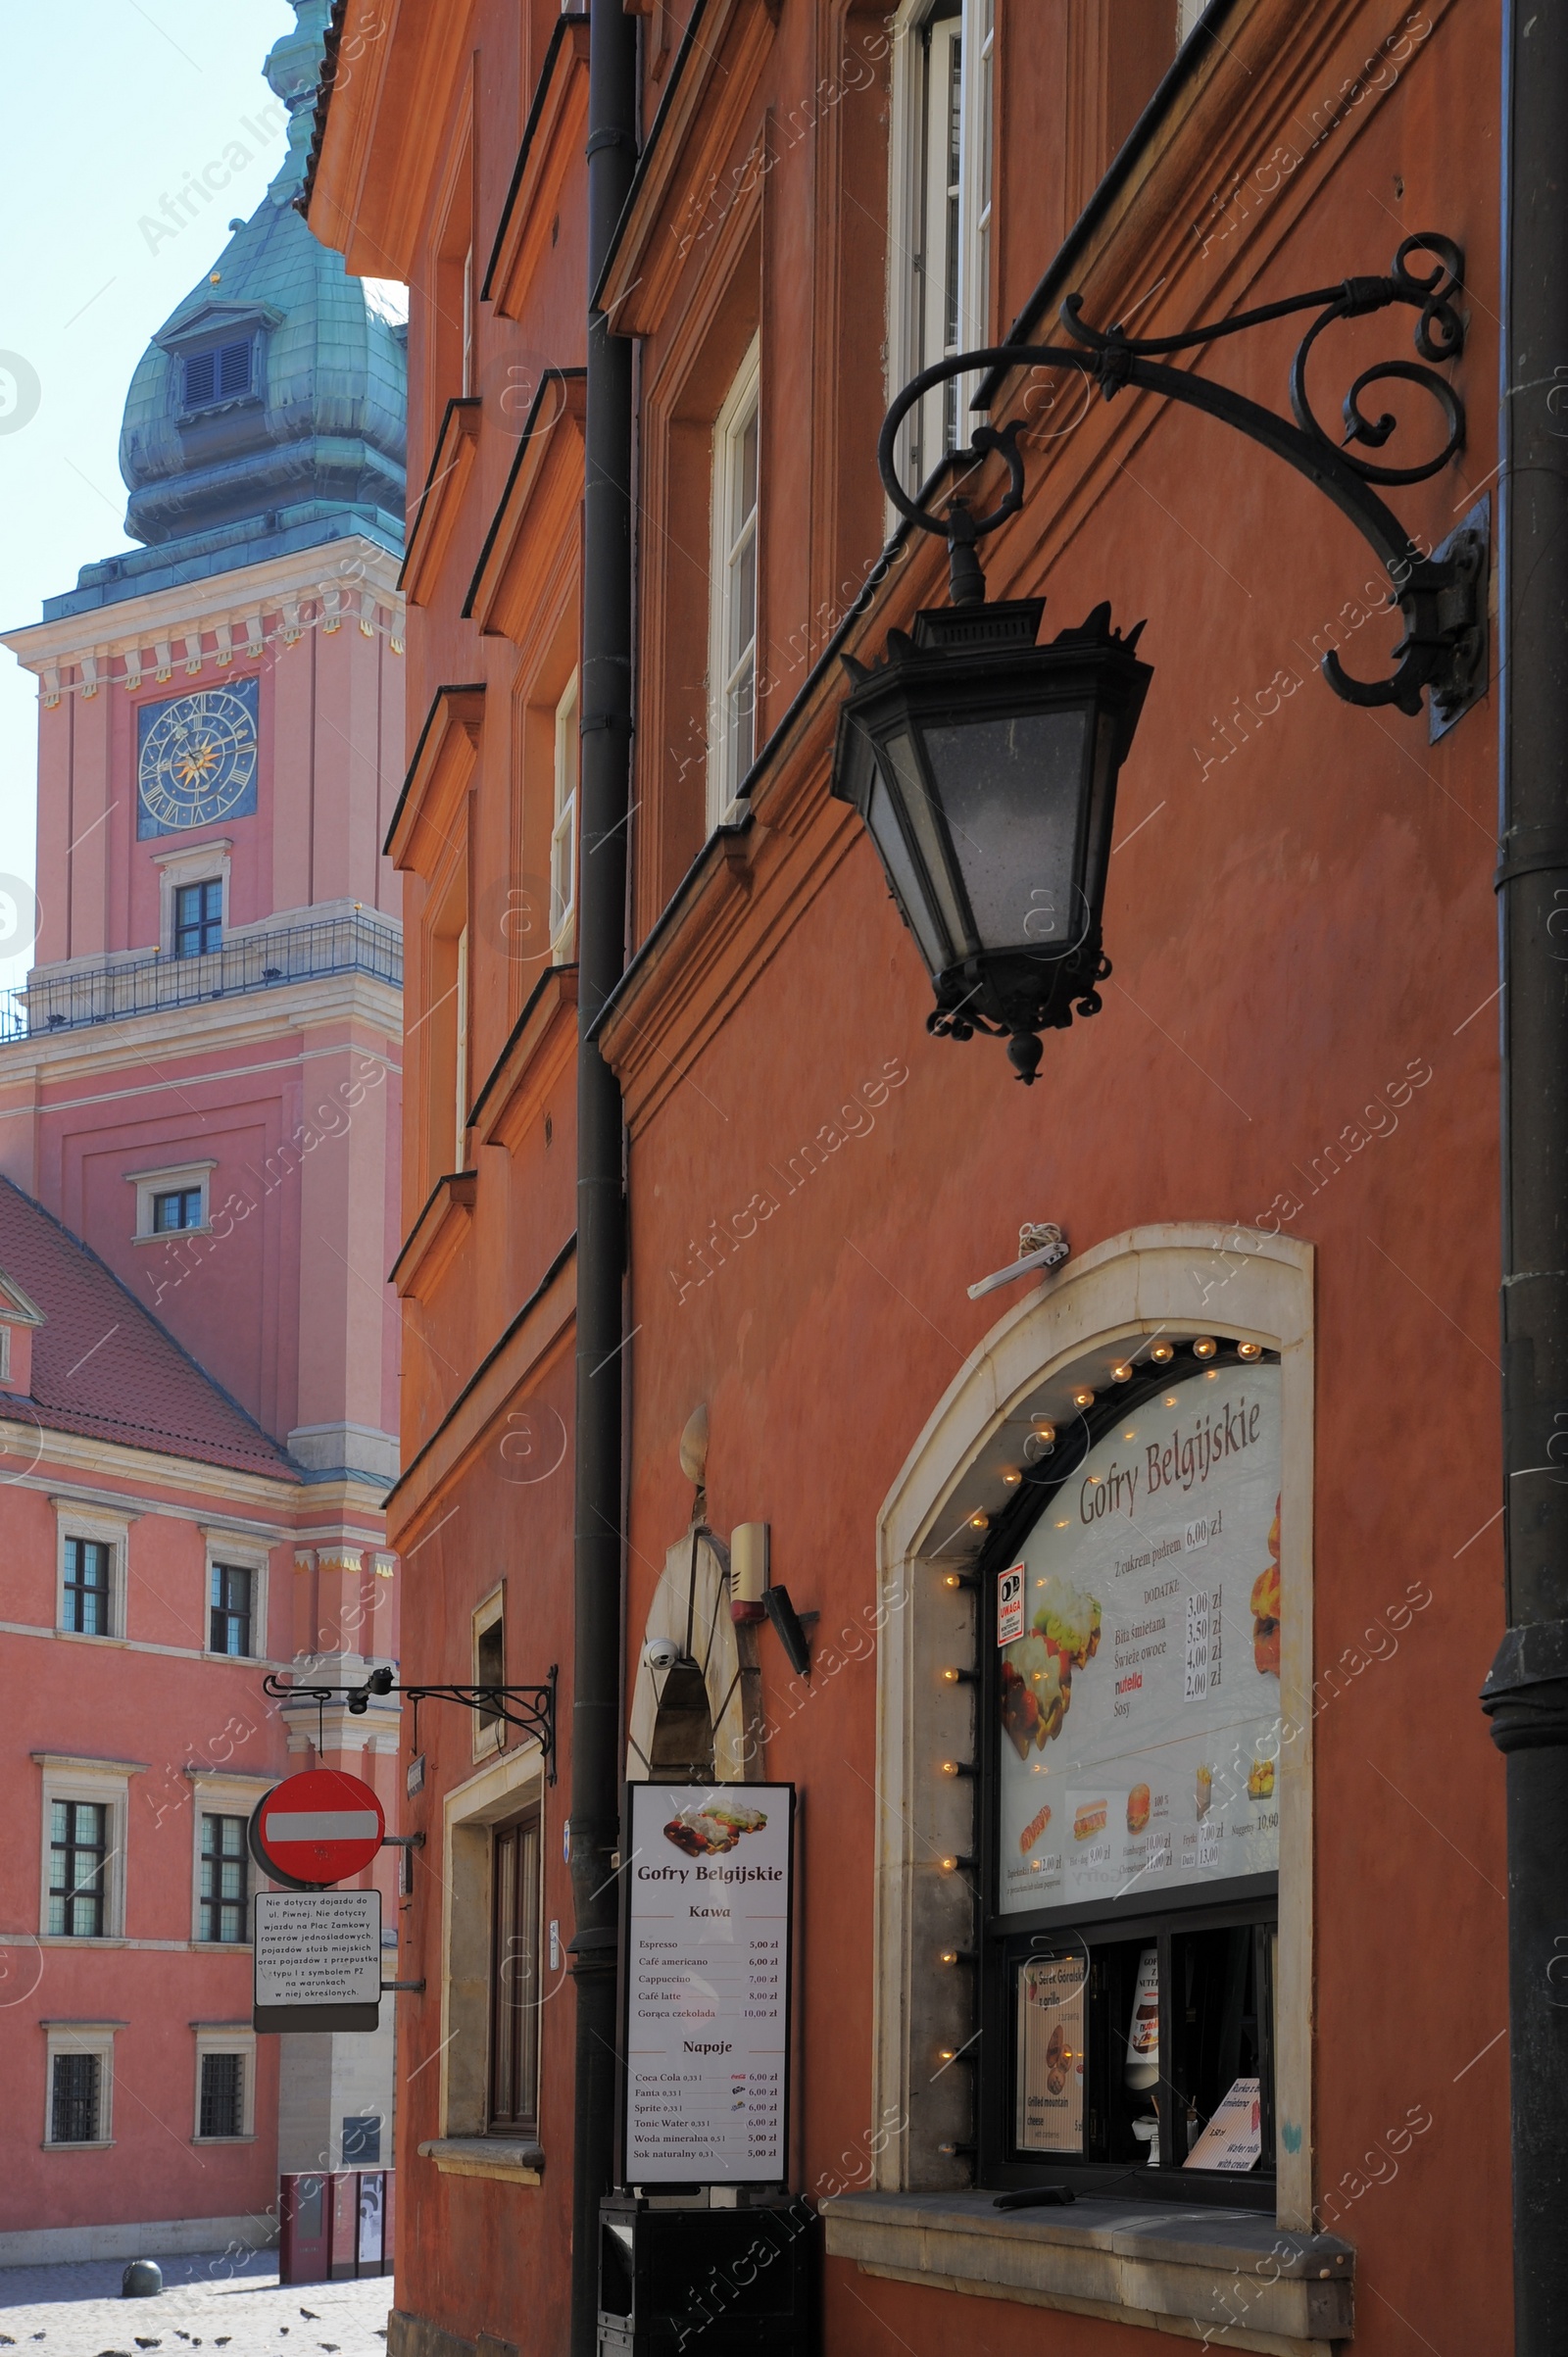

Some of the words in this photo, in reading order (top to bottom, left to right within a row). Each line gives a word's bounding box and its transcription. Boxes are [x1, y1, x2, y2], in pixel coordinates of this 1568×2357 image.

[1080, 1462, 1138, 1525] Gofry
[1146, 1397, 1260, 1492] Belgijskie
[1115, 1561, 1120, 1577] Z
[1122, 1552, 1151, 1575] cukrem
[1152, 1540, 1182, 1567] pudrem
[1187, 1520, 1206, 1547] 6,00
[1210, 1510, 1223, 1536] zł
[1001, 1599, 1020, 1618] UWAGA
[1115, 1629, 1130, 1645] Bita
[1131, 1618, 1166, 1640] śmietana
[1188, 1592, 1207, 1618] 3,00
[1212, 1584, 1222, 1609] zł
[1114, 1650, 1139, 1669] Świeże
[1141, 1642, 1166, 1660] owoce
[1188, 1619, 1207, 1645] 3,50
[1212, 1610, 1222, 1636] zł
[1115, 1671, 1143, 1695] nutella
[1187, 1645, 1206, 1669] 4,00
[1212, 1637, 1222, 1661] zł
[1113, 1701, 1130, 1717] Sosy
[1186, 1674, 1205, 1698] 2,00
[1210, 1662, 1222, 1687] zł
[1257, 1812, 1279, 1831] 10,00
[1183, 1834, 1198, 1845] Frytki
[1200, 1826, 1214, 1842] 7,00
[1216, 1822, 1223, 1839] zł
[1147, 1834, 1163, 1850] 10,00
[1164, 1833, 1171, 1848] zł
[1103, 1845, 1110, 1860] zł
[1166, 1850, 1172, 1866] zł
[1200, 1846, 1218, 1865] 13,00
[1055, 1855, 1061, 1870] zł
[638, 1866, 689, 1884] Gofry
[696, 1866, 783, 1884] Belgijskie
[284, 1898, 317, 1907] dotyczy
[689, 1905, 730, 1917] Kawa
[264, 1923, 293, 1932] wjazdu
[262, 1946, 302, 1955] pojazdów
[332, 1944, 371, 1953] miejskich
[639, 1940, 677, 1950] Espresso
[280, 1957, 320, 1966] pojazdów
[638, 1976, 690, 1985] Cappuccino
[1039, 1972, 1055, 1986] Serek
[1057, 1968, 1084, 1983] Góralski
[305, 1989, 359, 1998] określonych.
[1044, 1992, 1060, 2010] grilla
[638, 2010, 669, 2019] Gorąca
[683, 2040, 732, 2055] Napoje
[1028, 2097, 1044, 2107] Grilled
[1045, 2097, 1068, 2107] mountain
[1027, 2116, 1044, 2126] cheese
[653, 2150, 696, 2159] naturalny
[1227, 2144, 1246, 2153] Wafer
[1246, 2144, 1259, 2153] rolls
[1217, 2159, 1230, 2168] with
